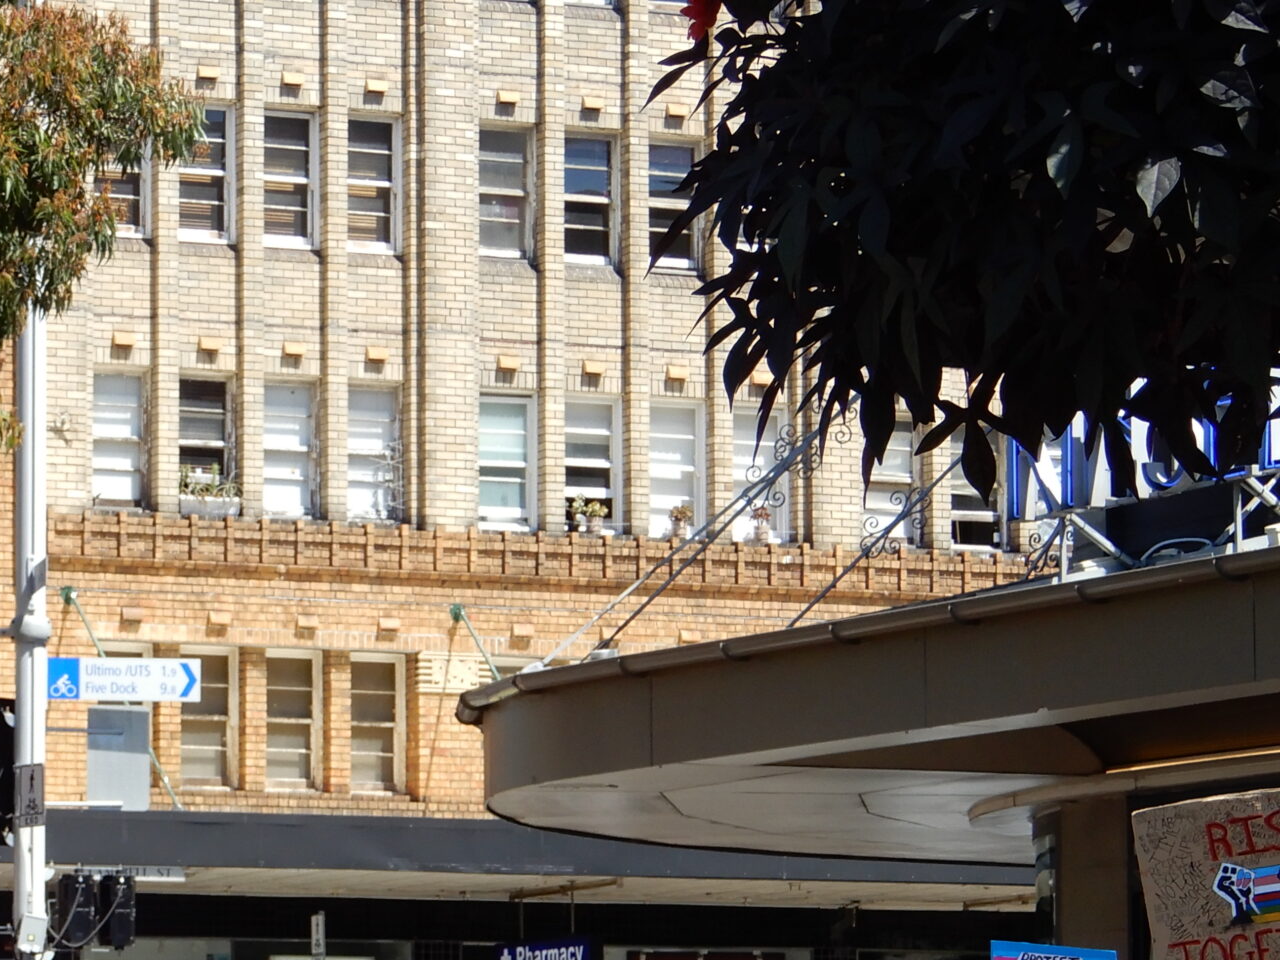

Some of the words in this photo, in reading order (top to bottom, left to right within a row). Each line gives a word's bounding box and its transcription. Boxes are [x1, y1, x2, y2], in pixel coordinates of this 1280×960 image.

[85, 664, 122, 677] Ultimo
[124, 664, 151, 678] /UTS
[85, 682, 107, 694] Five
[110, 682, 138, 694] Dock
